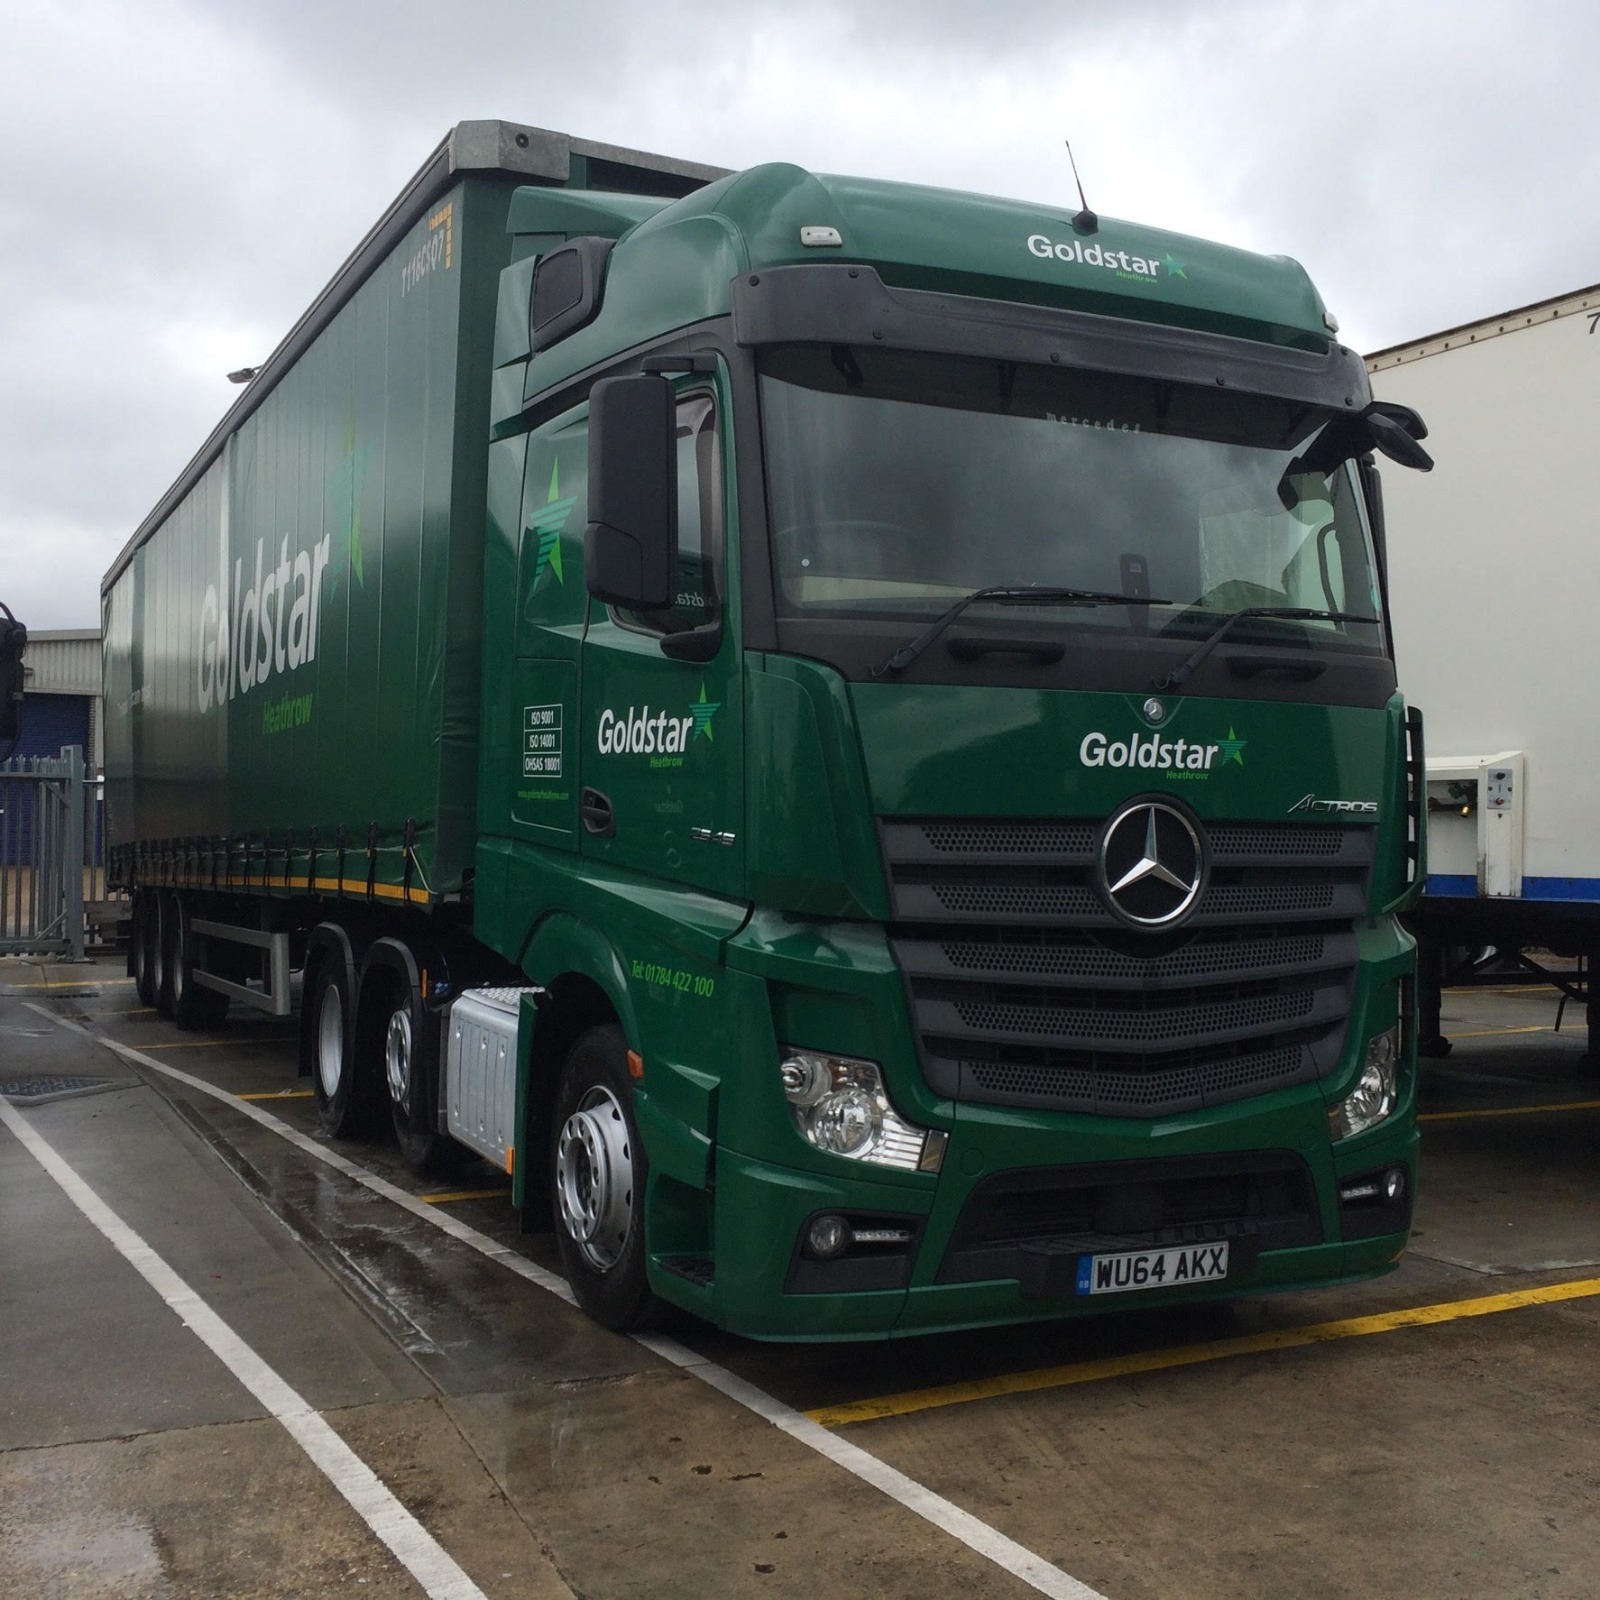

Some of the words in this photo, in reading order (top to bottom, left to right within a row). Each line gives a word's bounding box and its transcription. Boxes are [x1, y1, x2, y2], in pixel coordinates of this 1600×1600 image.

[1027, 234, 1160, 277] Goldstar
[1116, 270, 1158, 284] Heathrow
[1046, 412, 1140, 434] mercedes
[198, 532, 330, 714] Goldstar
[262, 691, 313, 736] Heathrow
[531, 711, 541, 724] ISO
[541, 710, 554, 723] 9001
[529, 735, 539, 748] ISO
[598, 705, 693, 754] Goldstar
[650, 756, 684, 768] Heathrow
[1079, 731, 1218, 769] Goldstar
[525, 758, 543, 771] OHSAS
[1166, 770, 1209, 780] Heathrow
[645, 963, 672, 987] 01784
[672, 971, 692, 992] 422
[694, 976, 715, 997] 100
[1097, 1254, 1166, 1289] WU64
[1174, 1247, 1226, 1281] AKX
